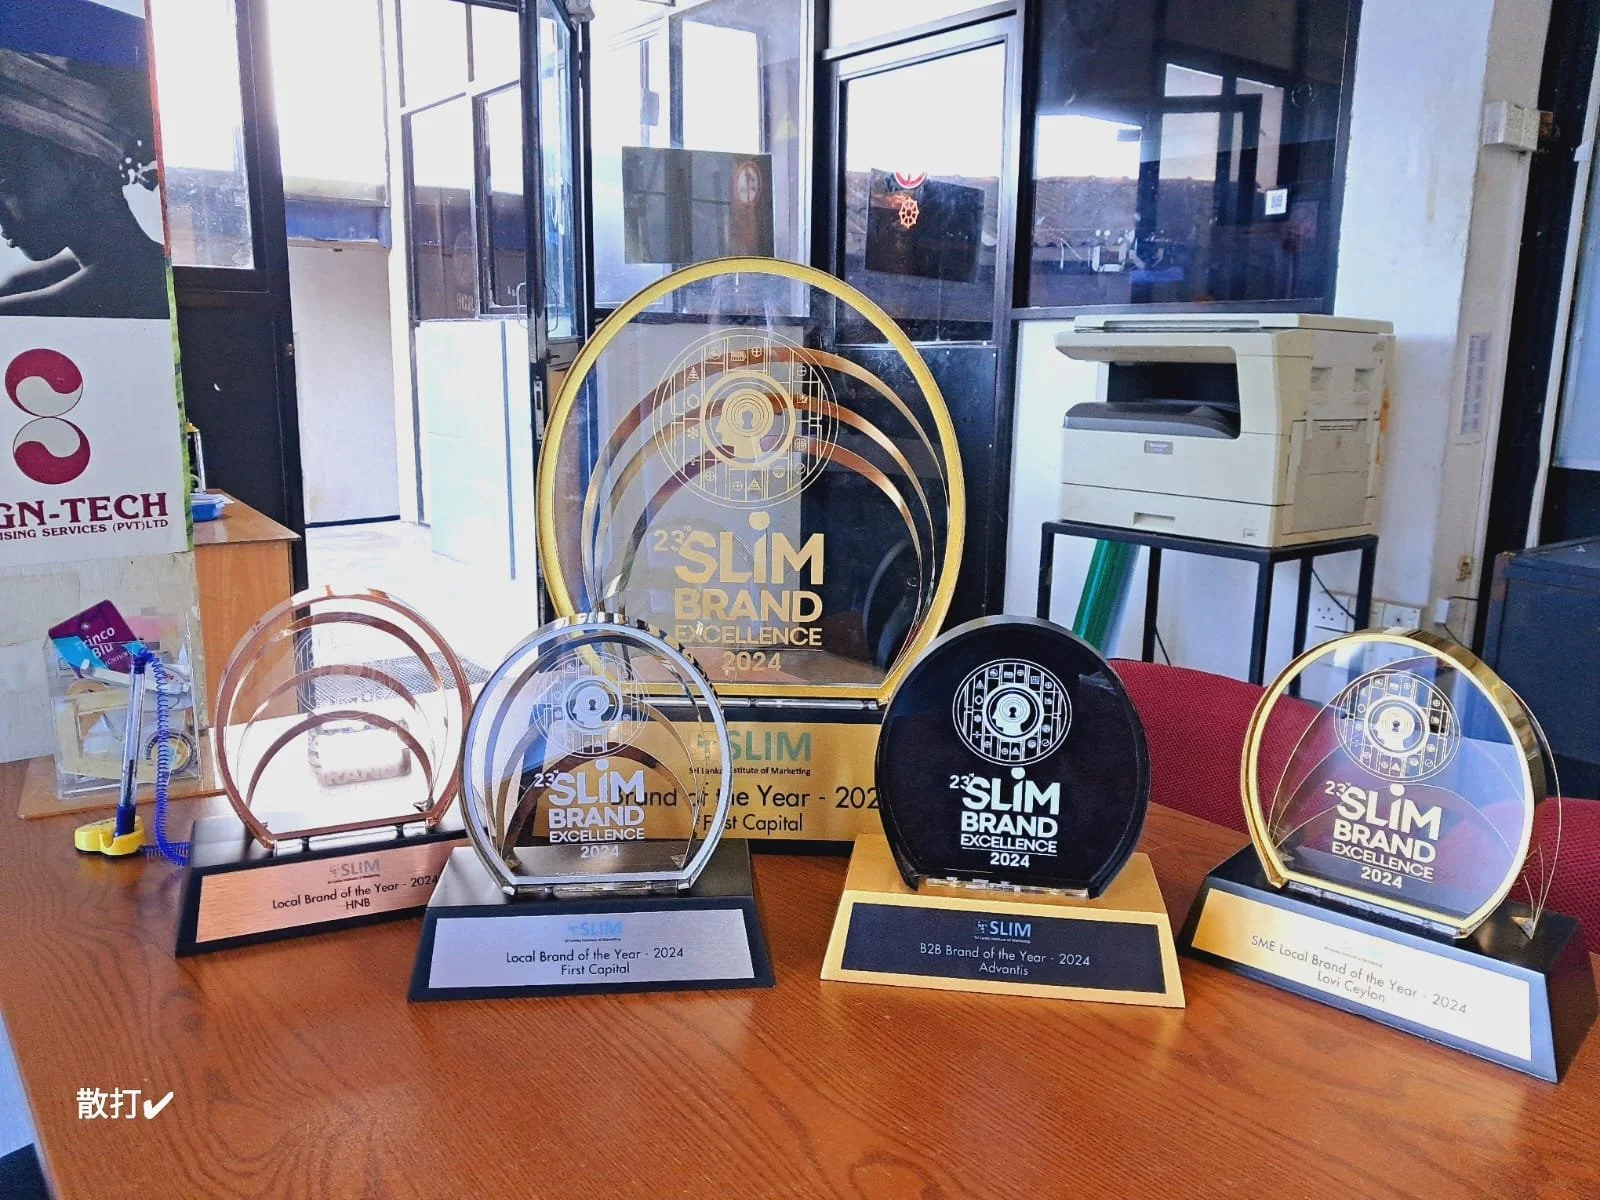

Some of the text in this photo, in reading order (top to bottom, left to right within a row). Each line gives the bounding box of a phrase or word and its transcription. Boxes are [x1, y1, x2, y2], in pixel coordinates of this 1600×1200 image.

[42, 523, 107, 537] SERVICES
[674, 587, 823, 623] BRAND
[674, 624, 823, 646] EXCELLENCE
[92, 643, 114, 658] Blu
[721, 651, 782, 672] 2024
[726, 729, 812, 762] SLIM
[761, 766, 769, 775] of
[771, 766, 811, 776] Marketing
[757, 785, 811, 807] Year
[548, 806, 645, 828] BRAND
[703, 813, 803, 835] Fst Capital
[961, 811, 1059, 838] BRAND
[549, 828, 646, 843] EXCELLENCE
[960, 833, 1058, 853] EXCELLENCE
[1333, 818, 1436, 864] BRAND
[580, 845, 620, 859] 2024
[990, 852, 1030, 868] 2024
[1331, 841, 1434, 880] EXCELLENCE
[341, 859, 380, 877] SLIM
[1360, 866, 1403, 889] 2024
[272, 895, 301, 910] Local
[304, 889, 337, 905] Brand
[340, 887, 352, 899] of
[355, 885, 371, 897] the
[374, 882, 399, 894] Year
[411, 873, 439, 888] 2024
[345, 898, 371, 911] HNB
[579, 920, 624, 937] SLIM
[989, 920, 1031, 938] SLIM
[506, 950, 536, 963] Local
[540, 949, 574, 962] Brand
[578, 948, 590, 961] of
[593, 948, 610, 960] the
[614, 948, 641, 960] Year
[653, 946, 684, 959] 2024
[920, 942, 942, 955] B2B
[945, 944, 979, 959] Brand
[983, 947, 996, 960] of
[998, 947, 1015, 961] the
[1019, 950, 1047, 964] Year
[1059, 953, 1090, 967] 2024
[561, 962, 630, 977] First Capital
[978, 962, 1029, 976] Advantis
[1251, 935, 1276, 952] SME
[1279, 943, 1308, 963] Local
[1311, 953, 1347, 975] Brand
[1350, 966, 1364, 980] of
[1366, 970, 1384, 988] the
[1388, 978, 1418, 998] Year
[1432, 993, 1468, 1014] 2024
[1317, 970, 1386, 1003] Lovi Ceylon
